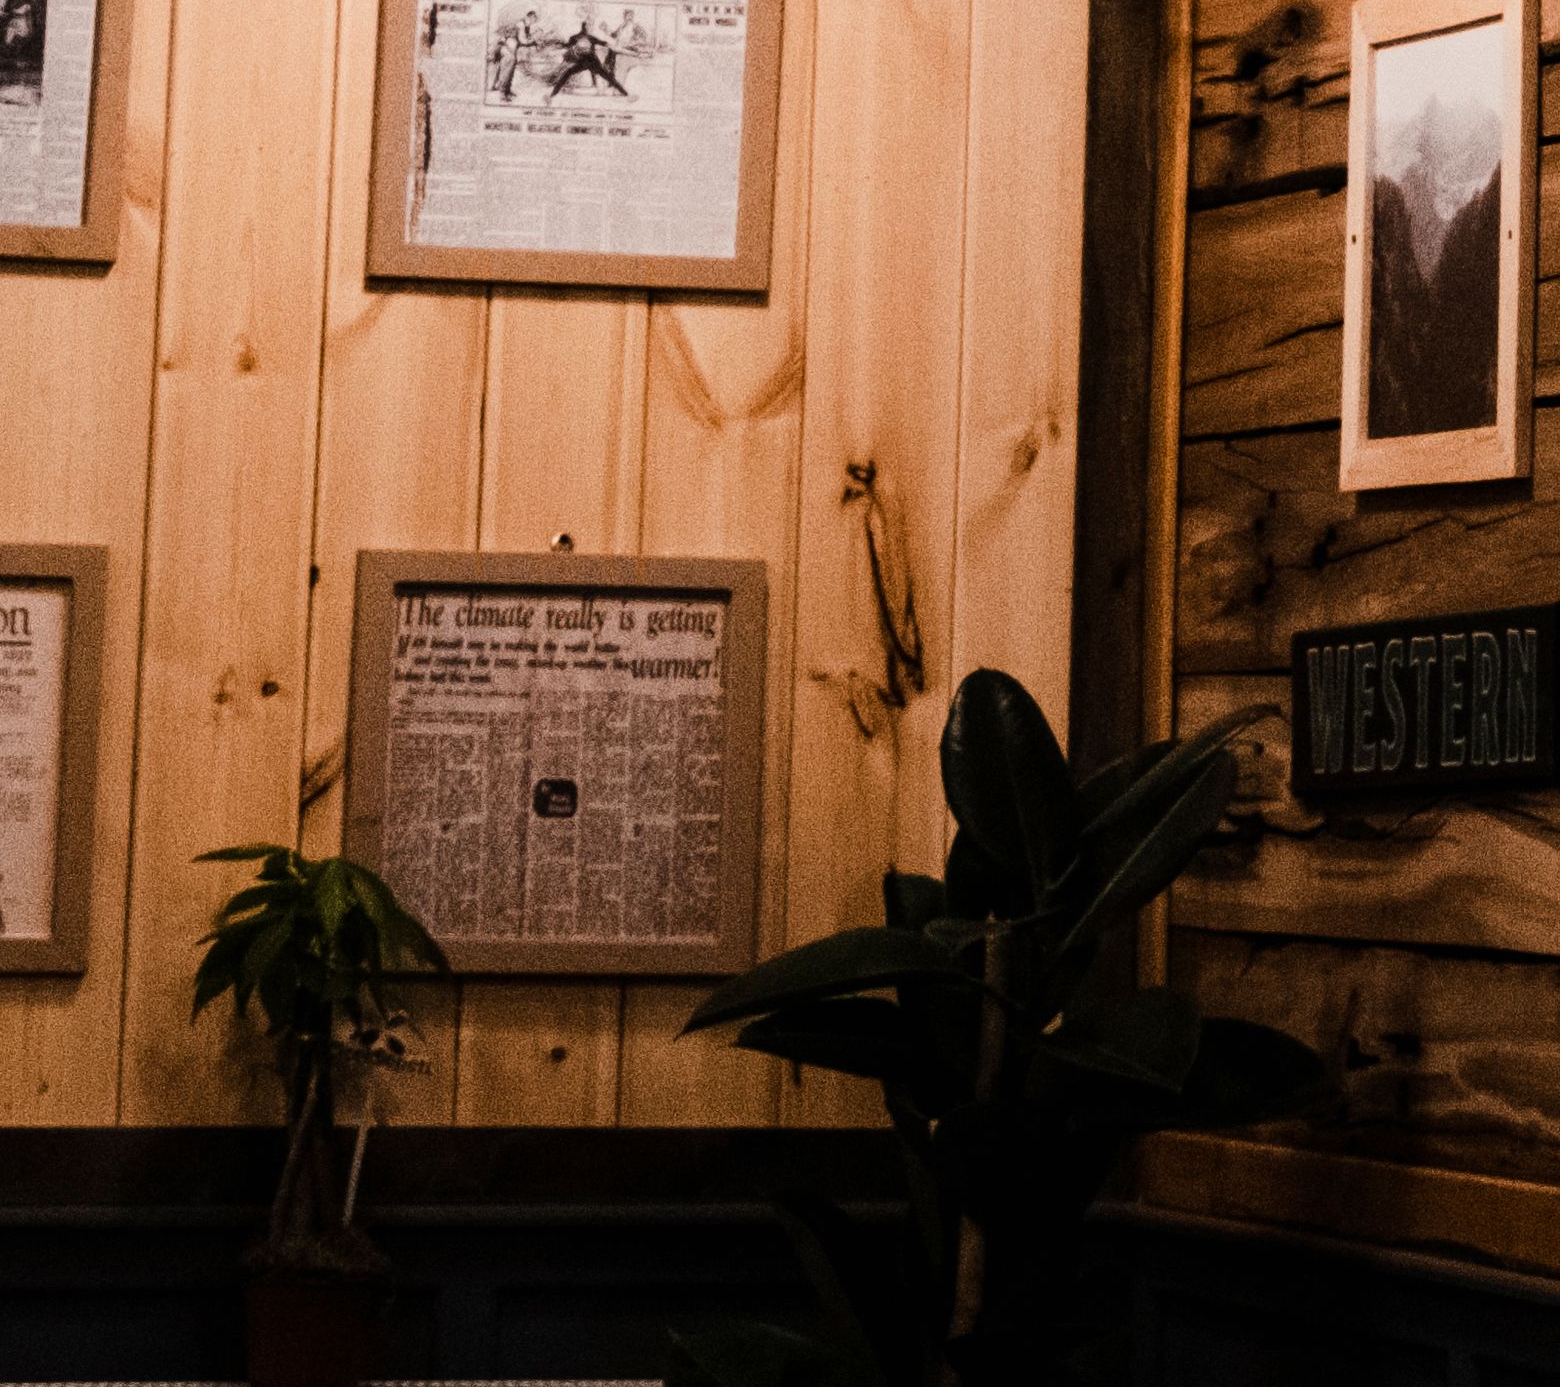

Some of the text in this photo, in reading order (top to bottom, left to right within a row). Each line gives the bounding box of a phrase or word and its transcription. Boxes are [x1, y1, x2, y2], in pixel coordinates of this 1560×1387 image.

[403, 593, 718, 640] The climate really is getting
[629, 646, 723, 679] warmer!
[1306, 628, 1538, 775] WESTERN
